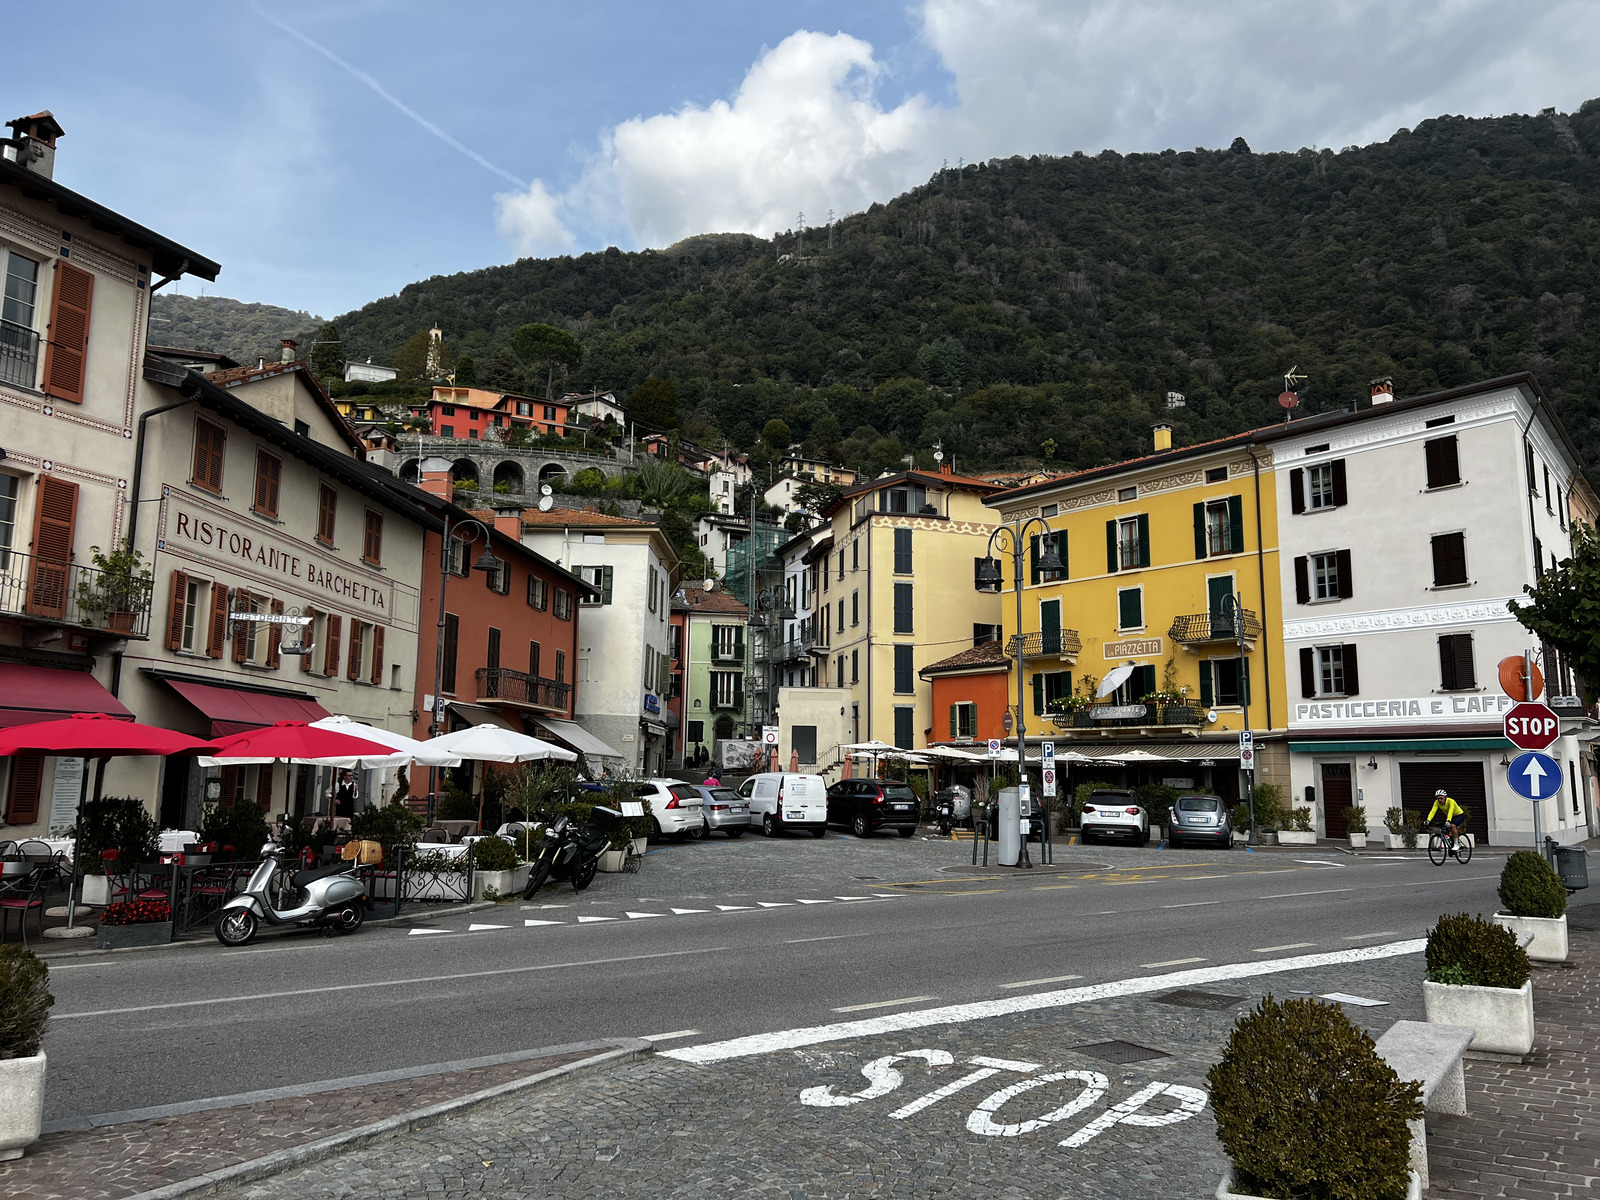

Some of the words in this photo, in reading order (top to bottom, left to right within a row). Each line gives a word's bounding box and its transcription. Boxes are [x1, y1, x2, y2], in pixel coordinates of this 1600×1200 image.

[176, 511, 301, 578] RISTORANTE
[307, 563, 385, 609] BARCHETTA
[234, 613, 302, 623] RISTORANTE
[1114, 641, 1159, 656] PIAZZETTA
[1297, 699, 1421, 720] PASTICCERIA
[1430, 699, 1443, 714] E
[1453, 696, 1515, 713] CAFF
[1508, 717, 1556, 736] STOP
[1242, 732, 1250, 742] P
[1044, 744, 1052, 757] P
[799, 1048, 1208, 1148] STOP
